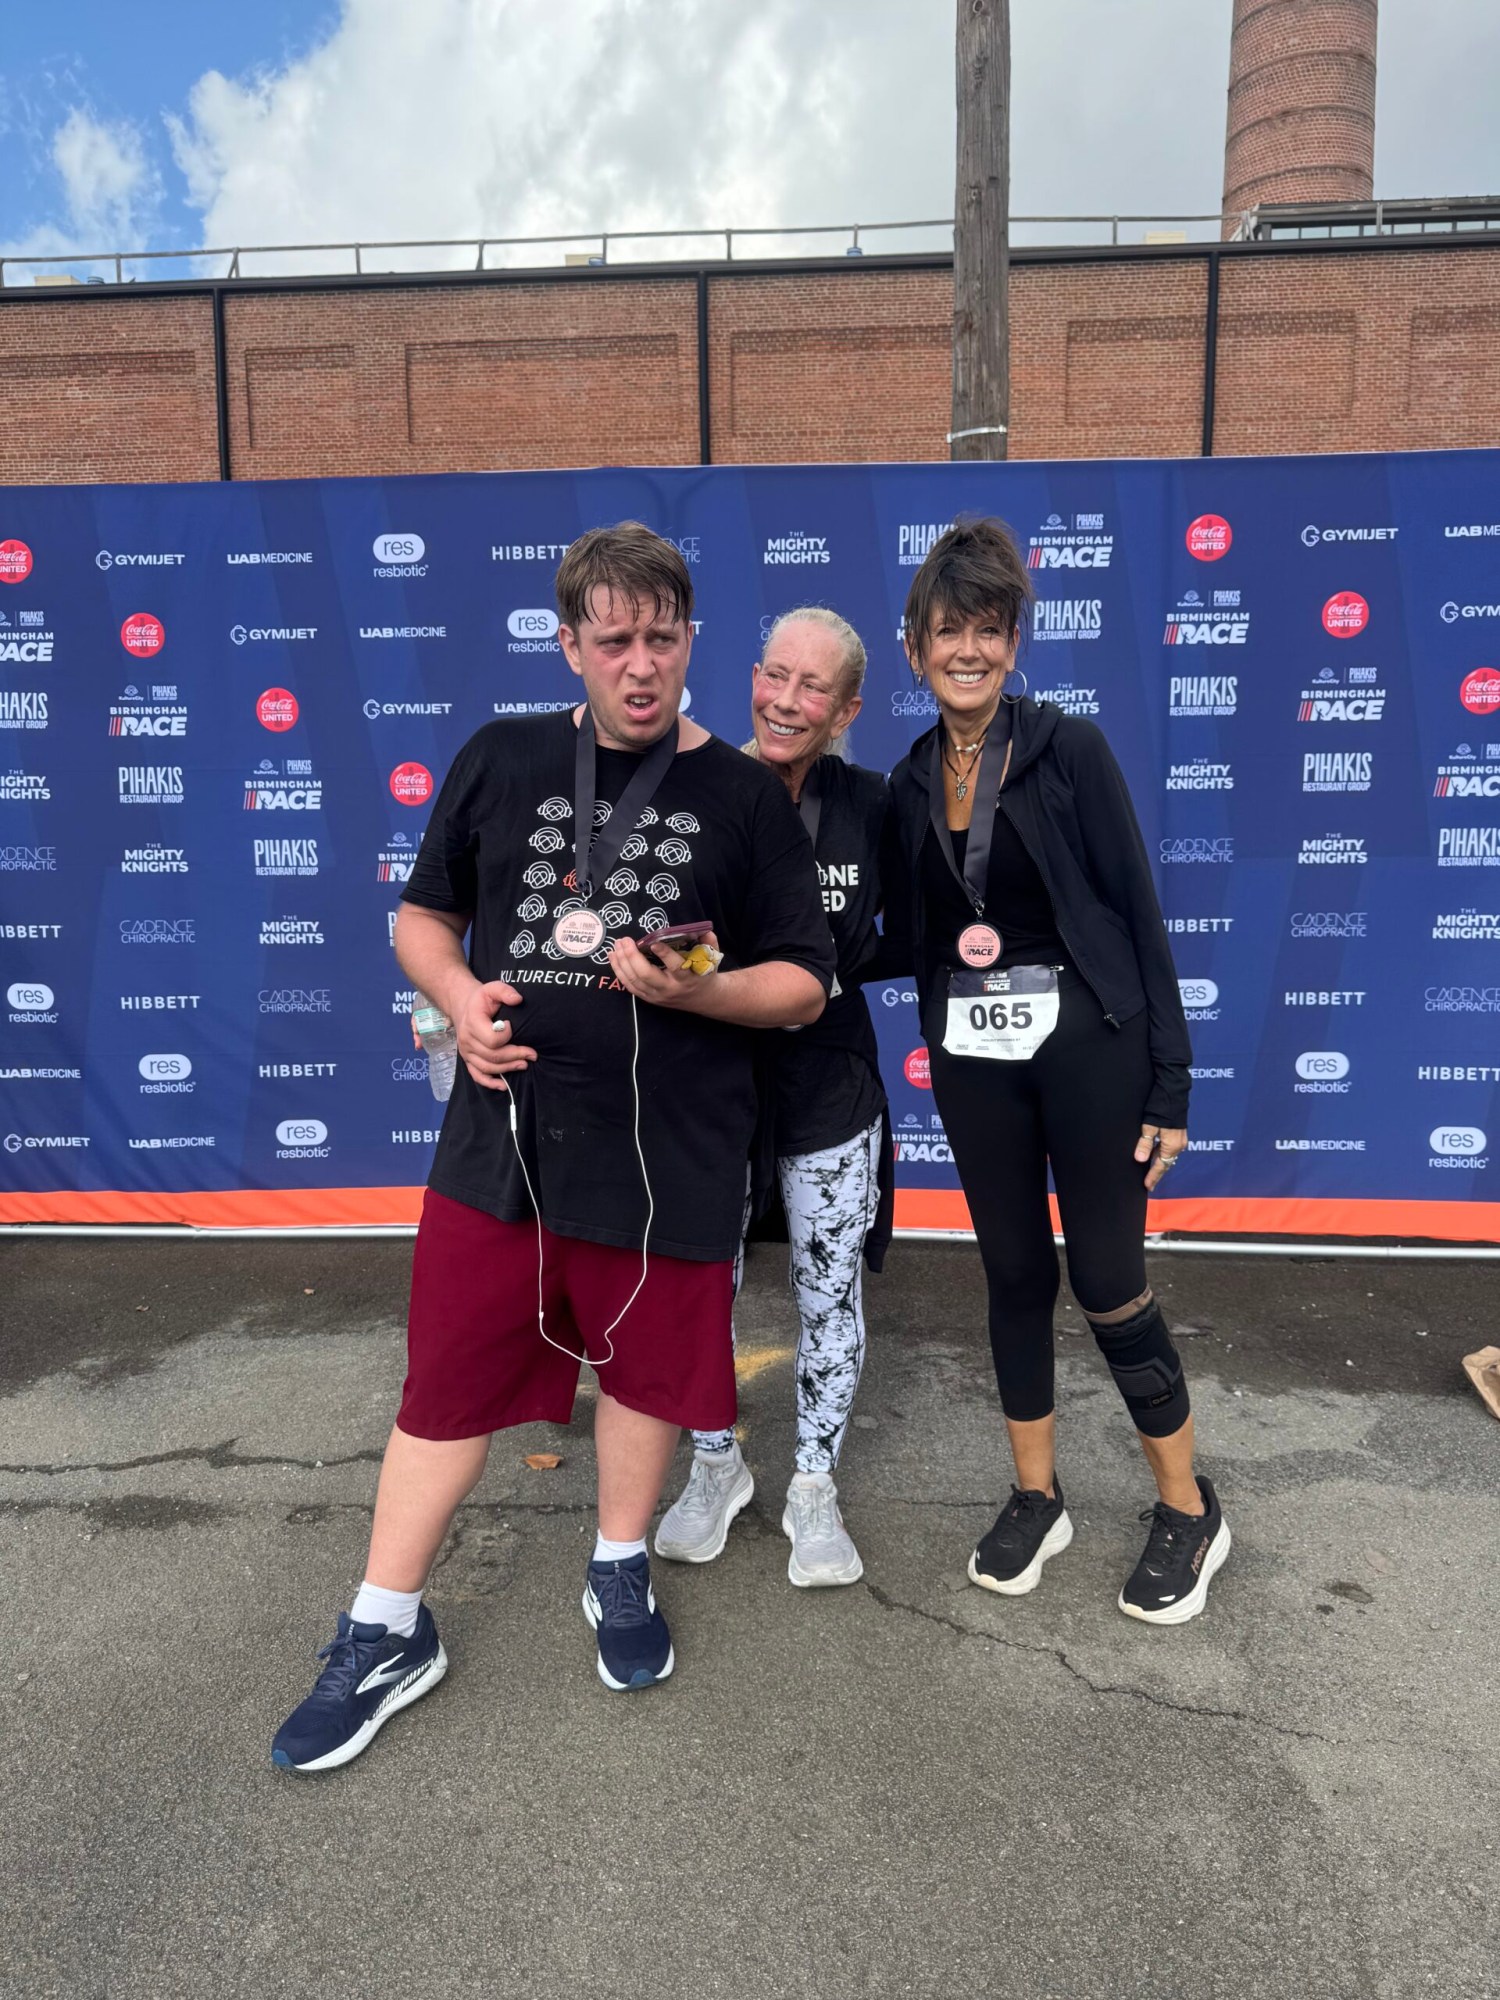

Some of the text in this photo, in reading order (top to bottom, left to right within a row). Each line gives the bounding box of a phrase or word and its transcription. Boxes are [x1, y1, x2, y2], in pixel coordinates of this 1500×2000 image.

[1322, 528, 1398, 541] GYMIJET
[768, 538, 827, 552] MIGHTY
[1030, 536, 1113, 545] BIRMINGHAM
[1191, 542, 1225, 550] UNITED
[384, 541, 414, 555] res
[115, 554, 185, 565] GYMIJET
[764, 551, 830, 564] KNIGHTS
[1038, 547, 1112, 568] RACE
[374, 565, 424, 577] resbiotic
[1034, 600, 1101, 631] PIHAKIS
[1167, 613, 1249, 622] BIRMINGHAM
[518, 613, 548, 631] res
[1328, 617, 1362, 627] UNITED
[0, 632, 53, 640] MINGHAM
[250, 628, 317, 639] GYMIJET
[1078, 630, 1101, 639] GROUP
[1175, 623, 1249, 644] RACE
[508, 640, 561, 652] resbiotic
[0, 642, 53, 662] ACE
[1035, 690, 1097, 703] MIGHTY
[1170, 677, 1237, 707] PIHAKIS
[1301, 690, 1385, 698] BIRMINGHAM
[0, 692, 48, 719] HAKIS
[383, 704, 452, 714] GYMIJET
[1214, 706, 1236, 715] GROUP
[1309, 700, 1385, 721] RACE
[26, 720, 48, 729] GROUP
[120, 717, 187, 736] RACE
[1171, 765, 1230, 776] MIGHTY
[1303, 753, 1372, 783] PIHAKIS
[1438, 766, 1500, 774] BIRMINGH
[1, 776, 46, 787] IGHTY
[119, 767, 183, 794] PIHAKIS
[1166, 778, 1233, 789] KNIGHTS
[1348, 782, 1371, 791] GROUP
[1445, 776, 1500, 797] RAC
[0, 788, 50, 799] NIGHTS
[162, 793, 184, 803] GROUP
[254, 790, 321, 809] RACE
[1303, 839, 1364, 851] MIGHTY
[125, 850, 184, 860] MIGHTY
[254, 840, 318, 866] PIHAKIS
[1160, 852, 1233, 863] CHIROPRACTIC
[1298, 852, 1367, 863] KNIGHTS
[122, 862, 188, 872] KNIGHTS
[298, 867, 318, 875] GROUP
[1165, 919, 1233, 932] IBBETT
[1437, 915, 1500, 926] MIGHTY
[0, 925, 61, 938] IBBETT
[262, 922, 320, 934] MIGHTY
[1291, 926, 1366, 937] CHIROPRACTIC
[121, 933, 195, 943] CHIROPRACTIC
[260, 933, 324, 944] KNIGHTS
[17, 990, 44, 1003] res
[1285, 992, 1365, 1005] HIBBETT
[121, 996, 200, 1009] HIBBETT
[260, 1002, 331, 1012] CHIROPRACTIC
[9, 1012, 57, 1023] resbiotic
[969, 1002, 1033, 1031] 065
[1184, 1009, 1219, 1020] biotic
[150, 1061, 180, 1074] res
[260, 1064, 336, 1077] HIBBETT
[1307, 1059, 1337, 1072] res
[1188, 1068, 1234, 1078] EDICINE
[140, 1082, 193, 1093] resbiotic
[1294, 1082, 1348, 1093] resbiotic
[287, 1126, 316, 1139] res
[25, 1137, 90, 1147] GYMIJET
[1187, 1140, 1234, 1150] MIJET
[1442, 1134, 1473, 1148] res
[277, 1147, 328, 1158] resbiotic
[1429, 1156, 1484, 1168] resbiotic
